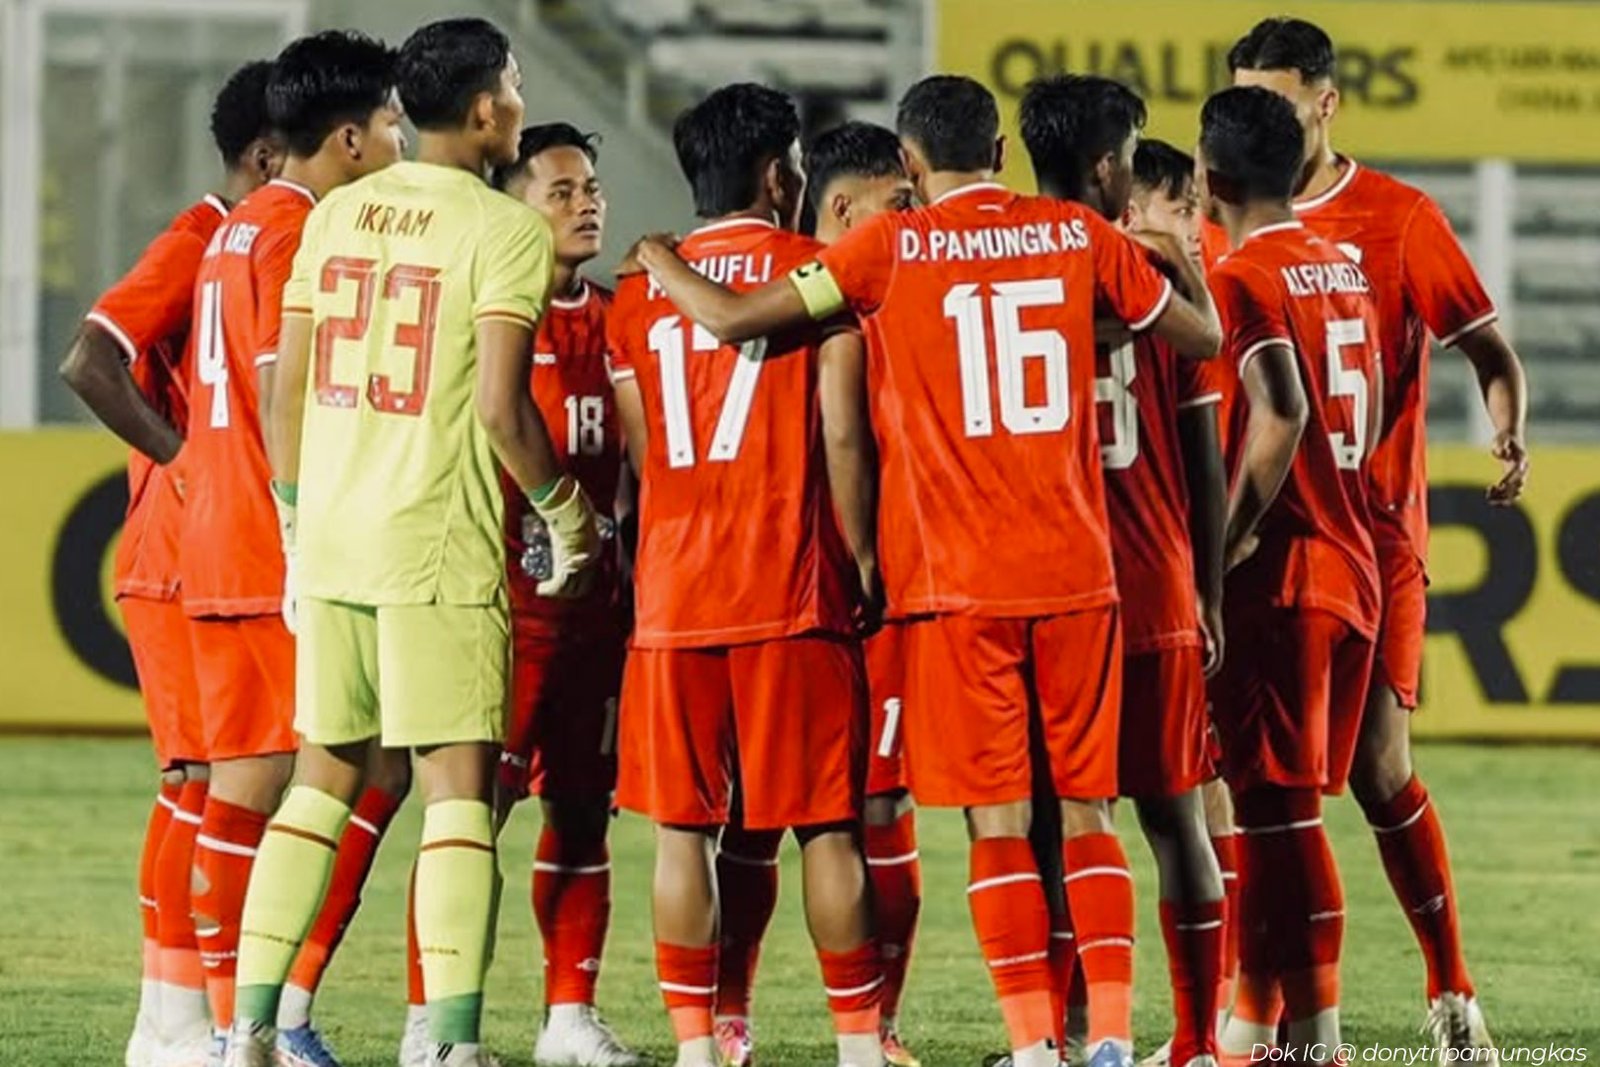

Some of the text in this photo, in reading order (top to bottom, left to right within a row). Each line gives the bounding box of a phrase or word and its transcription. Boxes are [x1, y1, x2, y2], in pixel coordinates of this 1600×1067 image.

[354, 202, 434, 237] IKRAM
[899, 218, 1089, 262] D.PAMUNGKAS
[198, 280, 229, 428] 4
[314, 255, 442, 417] 23
[648, 314, 769, 469] 17
[943, 277, 1070, 438] 16
[1325, 318, 1369, 469] 5
[564, 395, 604, 457] 18
